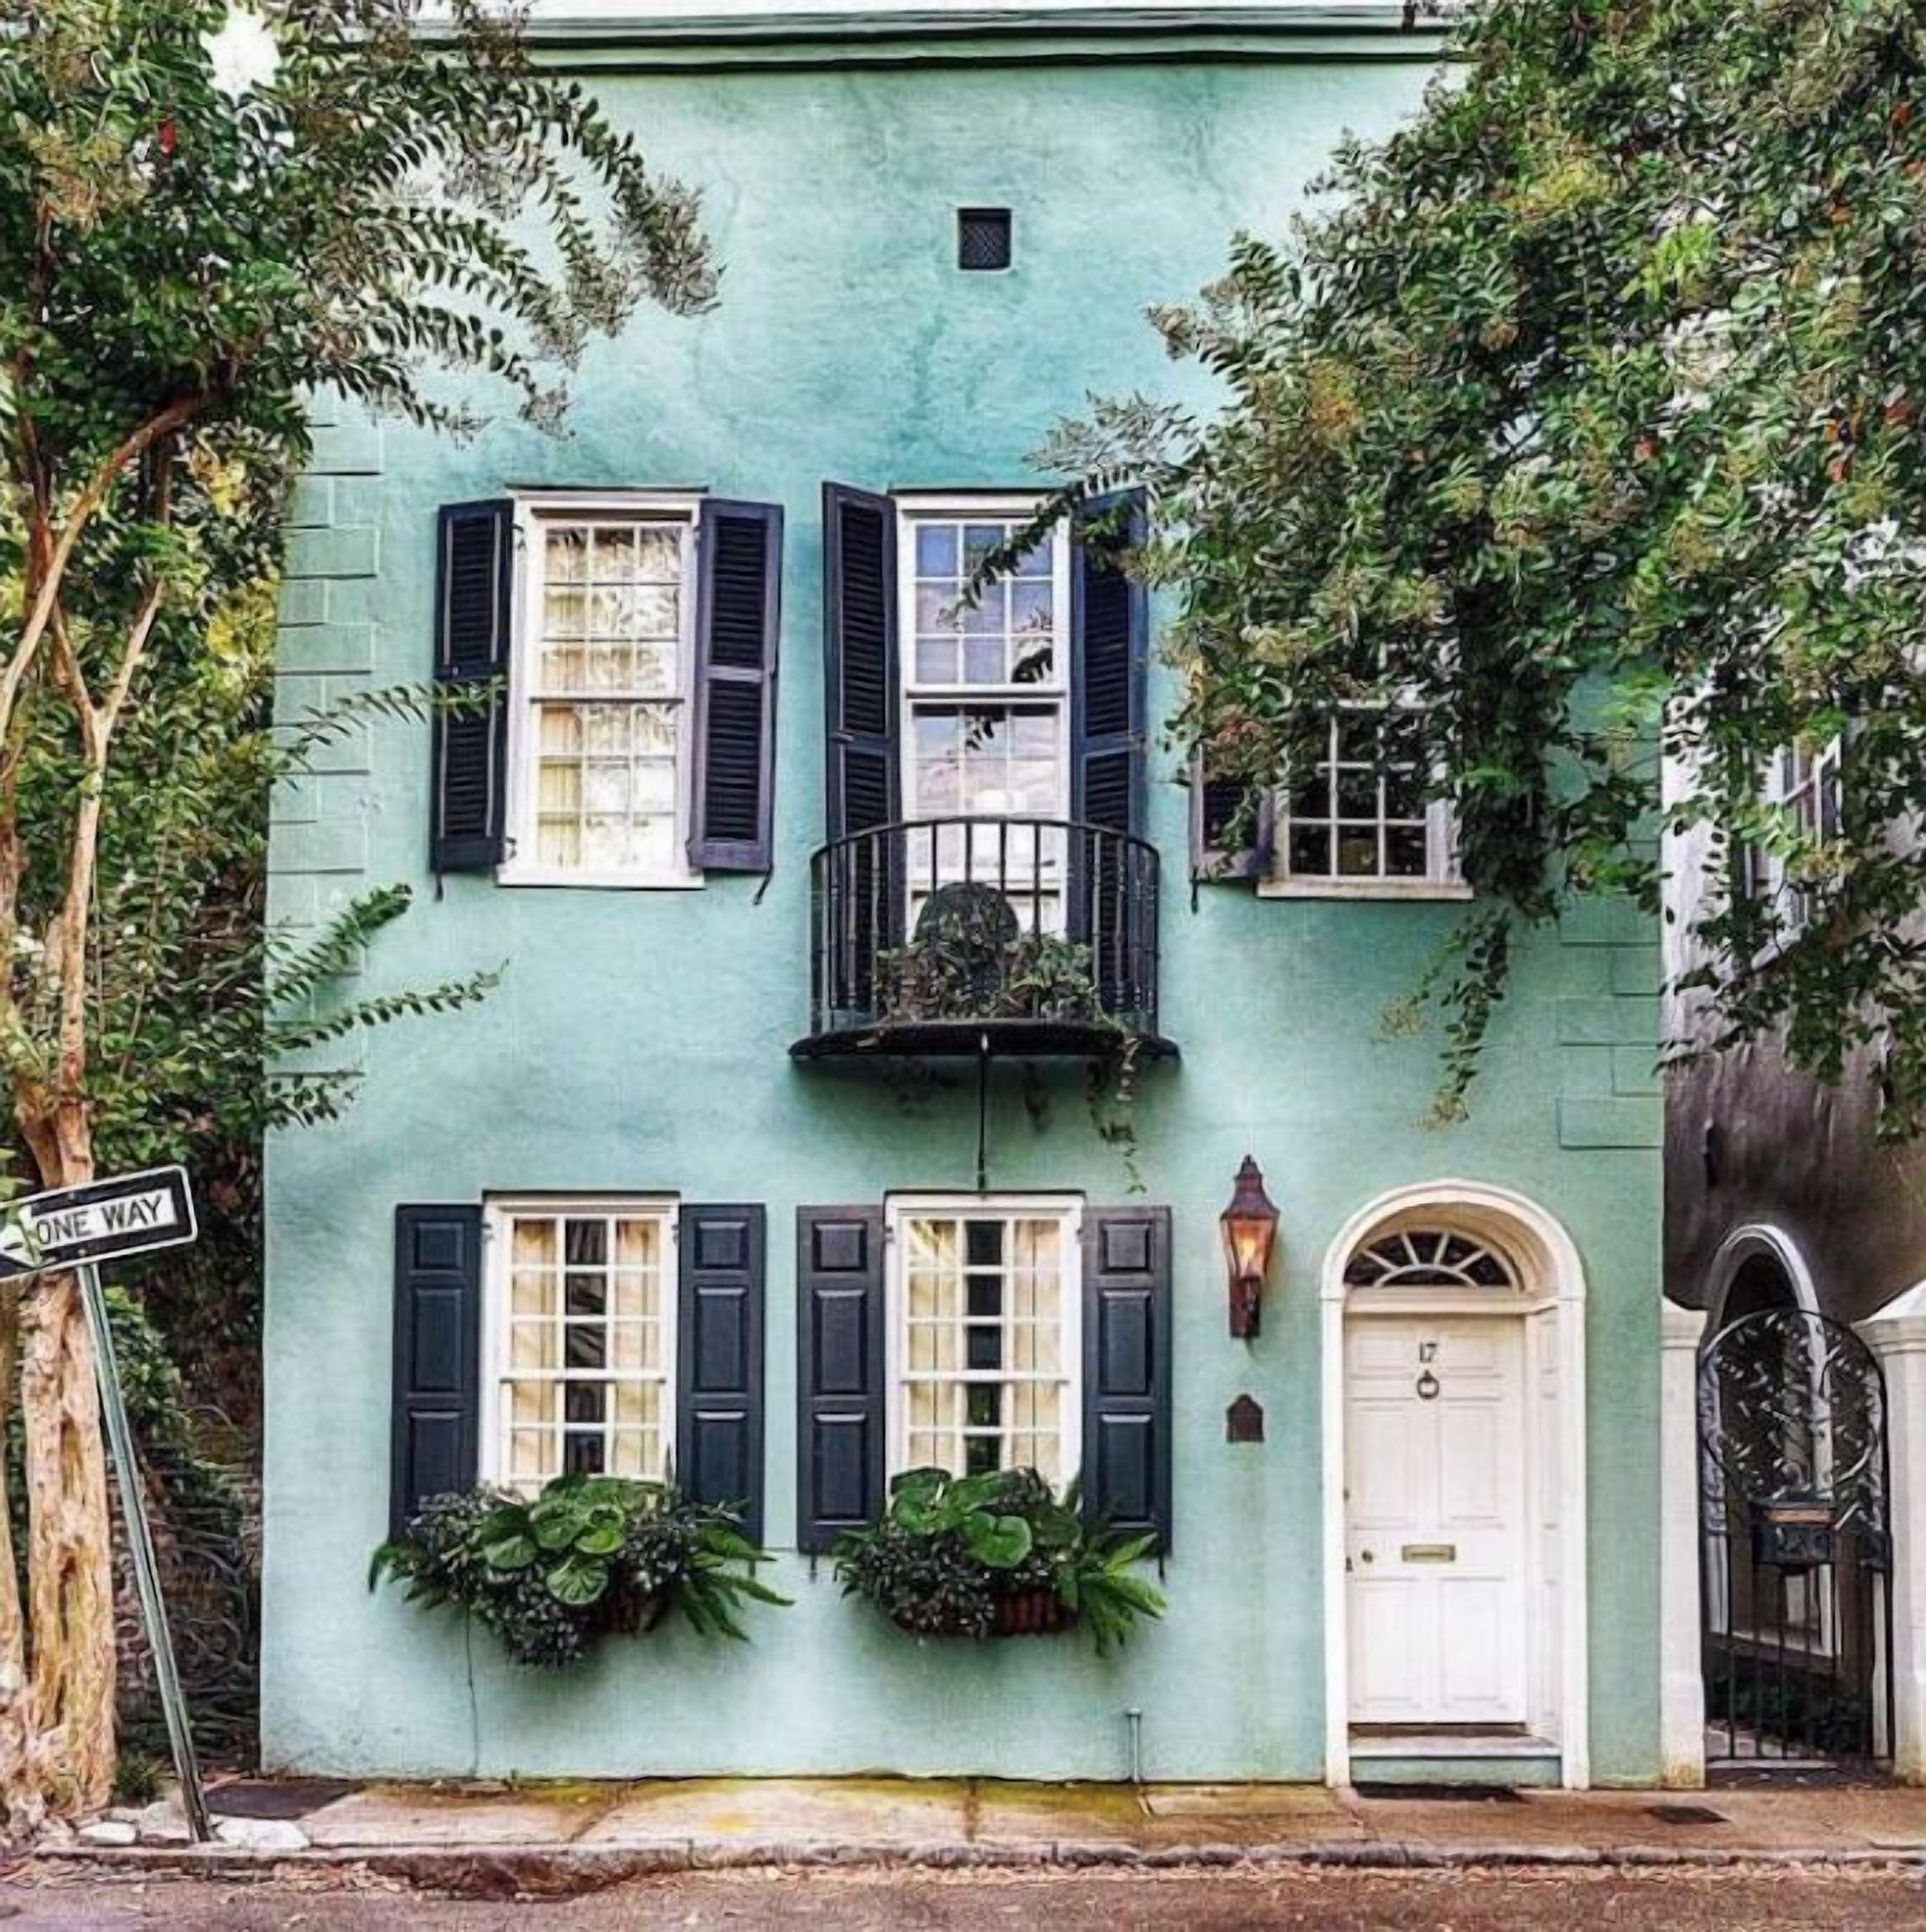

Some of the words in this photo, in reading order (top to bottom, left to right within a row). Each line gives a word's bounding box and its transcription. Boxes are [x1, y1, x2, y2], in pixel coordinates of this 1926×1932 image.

[37, 1211, 92, 1245] ONE
[102, 1194, 162, 1231] WAY
[1419, 1342, 1437, 1363] 17
